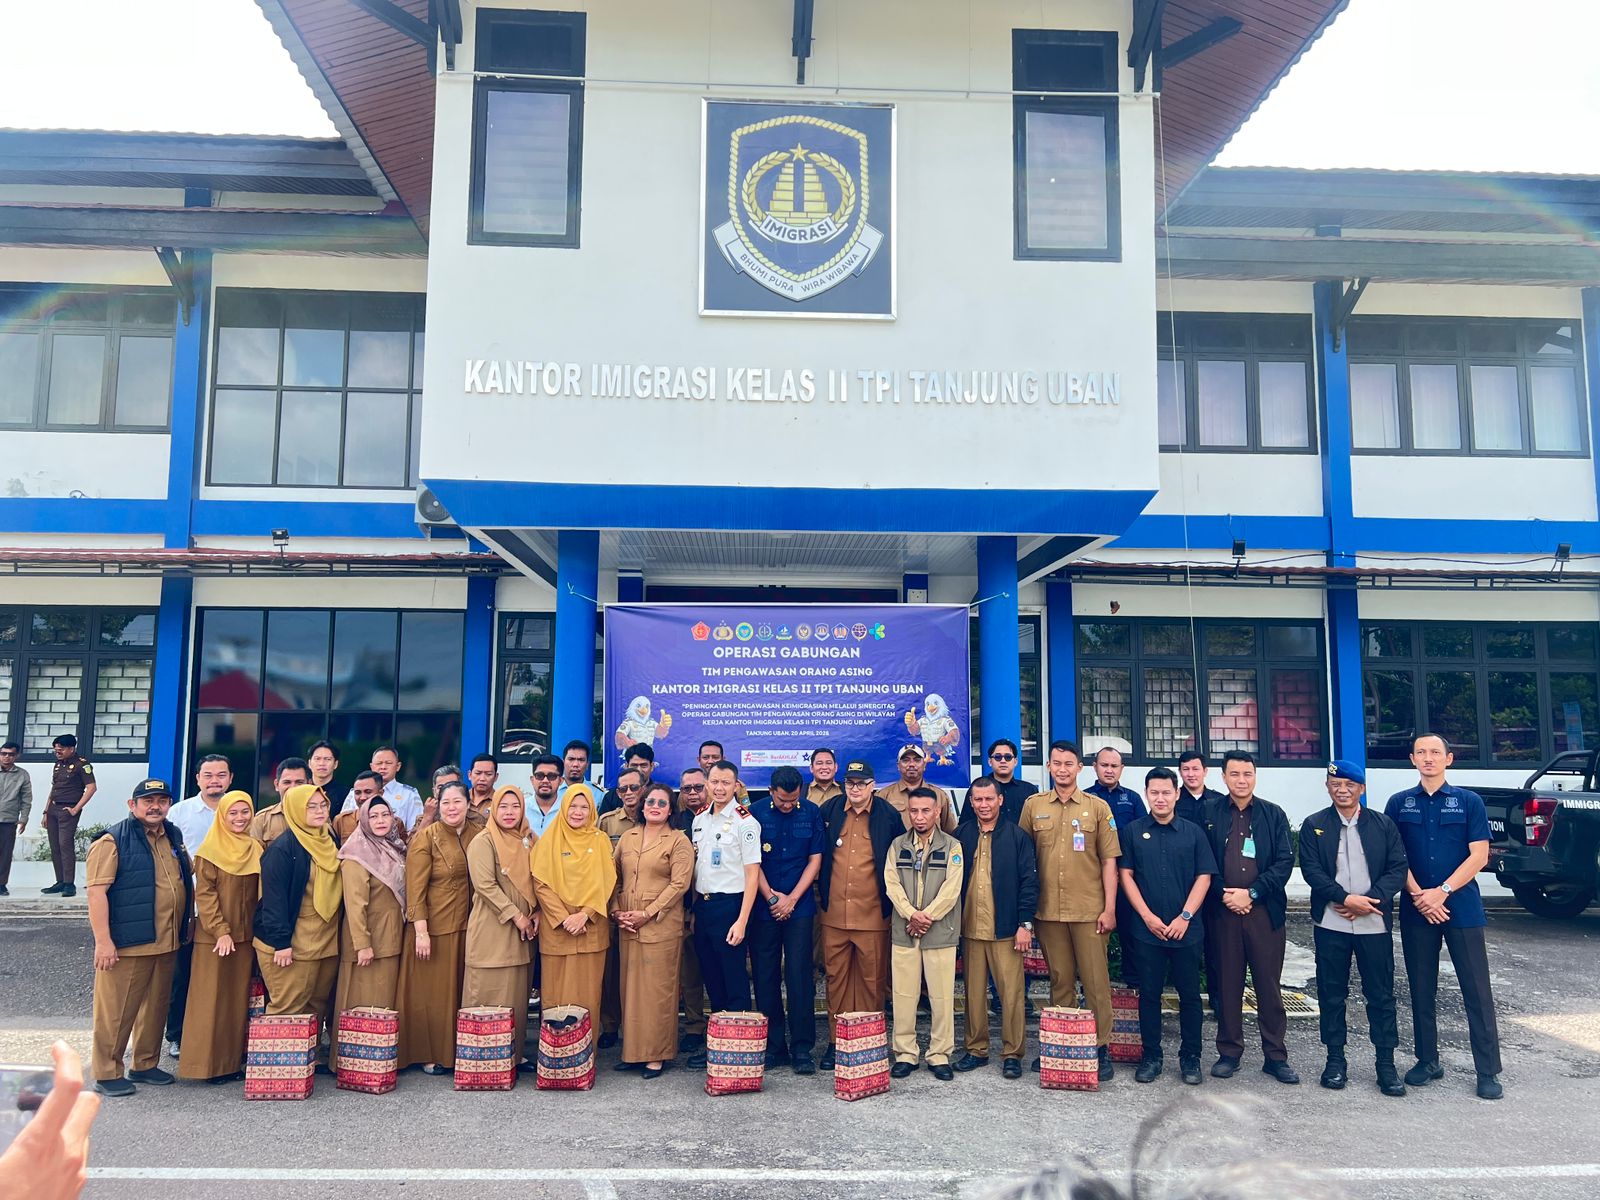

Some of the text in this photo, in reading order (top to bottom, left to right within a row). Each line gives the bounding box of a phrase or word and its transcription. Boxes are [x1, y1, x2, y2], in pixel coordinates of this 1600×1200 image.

[763, 219, 833, 241] IMIGRASI
[739, 252, 860, 293] BHUMI PURA WIRA WIBAWA
[464, 359, 1121, 406] KANTOR IMIGRASI KELAS II TPI TANJUNG UBAN
[713, 646, 861, 658] OPERASI GABUNGAN
[701, 667, 873, 677] TIM PENGAWASAN ORANG ASING
[652, 684, 924, 694] KANTOR IMIGRASI KELAS II TPI TANJUNG UBAN
